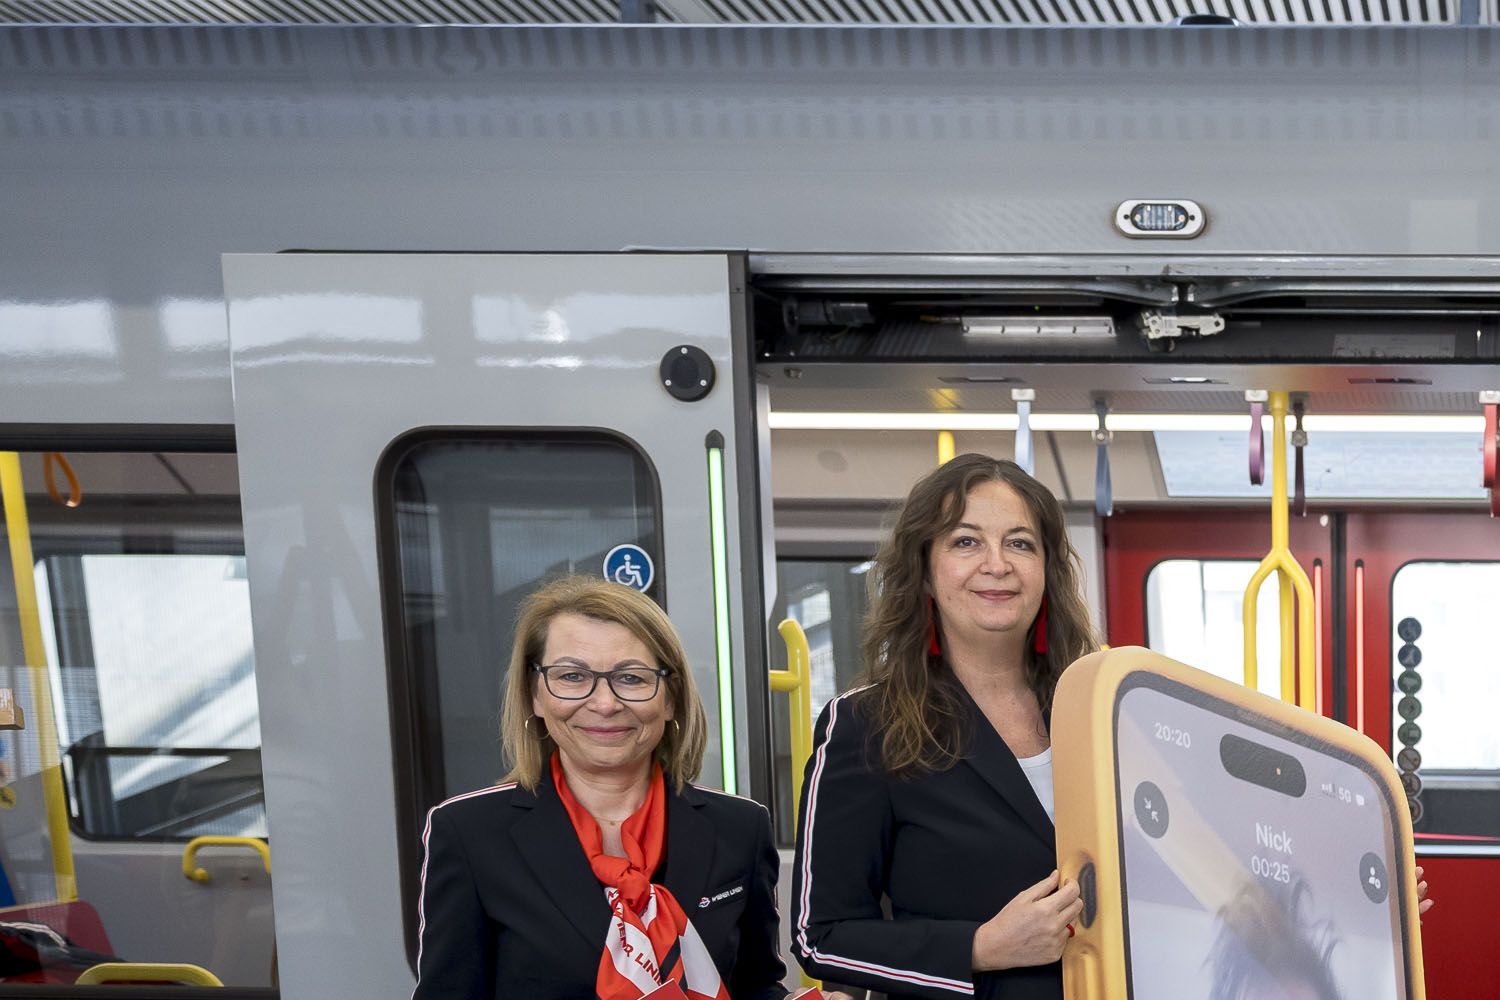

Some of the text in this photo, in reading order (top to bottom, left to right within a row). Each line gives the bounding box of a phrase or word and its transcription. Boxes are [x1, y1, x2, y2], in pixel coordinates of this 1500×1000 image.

[1154, 721, 1192, 749] 20:20
[1255, 821, 1293, 855] Nick
[1251, 855, 1291, 884] 00:25
[634, 952, 663, 987] LINI
